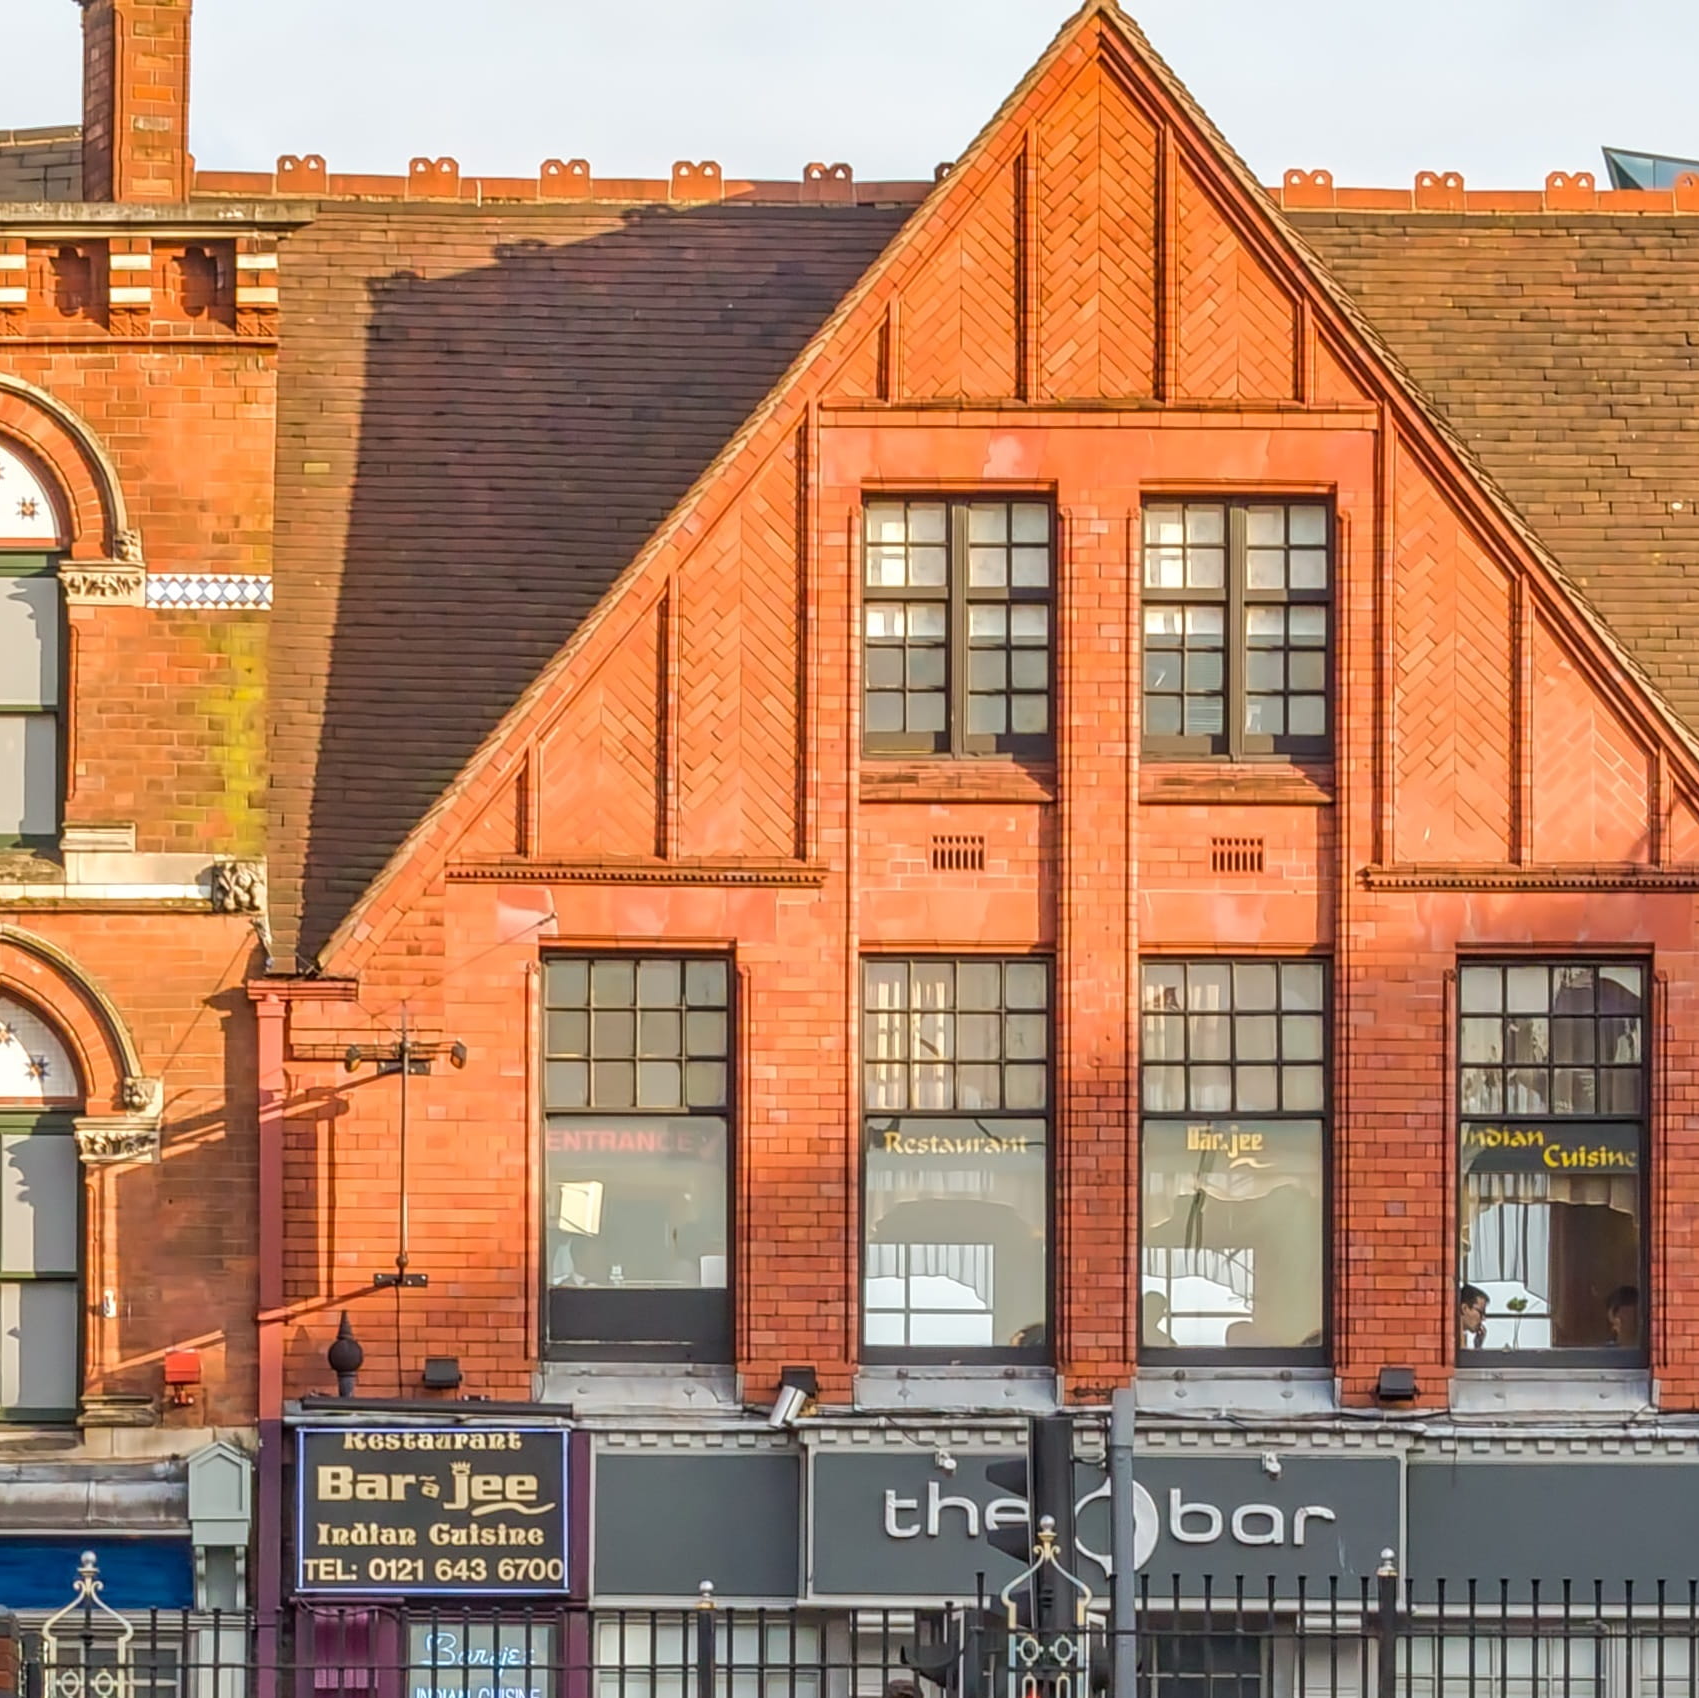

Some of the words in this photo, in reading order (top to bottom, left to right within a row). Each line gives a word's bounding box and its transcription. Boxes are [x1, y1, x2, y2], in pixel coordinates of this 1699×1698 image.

[548, 1130, 695, 1151] ENTRANCE
[884, 1131, 1028, 1154] Restaurant
[1462, 1126, 1544, 1147] Indian
[1544, 1144, 1637, 1168] Cuisine
[343, 1432, 522, 1450] Restaurant
[1169, 1488, 1337, 1546] bar
[317, 1523, 417, 1546] Indian
[429, 1523, 545, 1546] Cuisine
[304, 1558, 358, 1581] TEL:
[368, 1558, 424, 1581] 0121
[434, 1558, 488, 1581] 643
[497, 1558, 564, 1581] 6700
